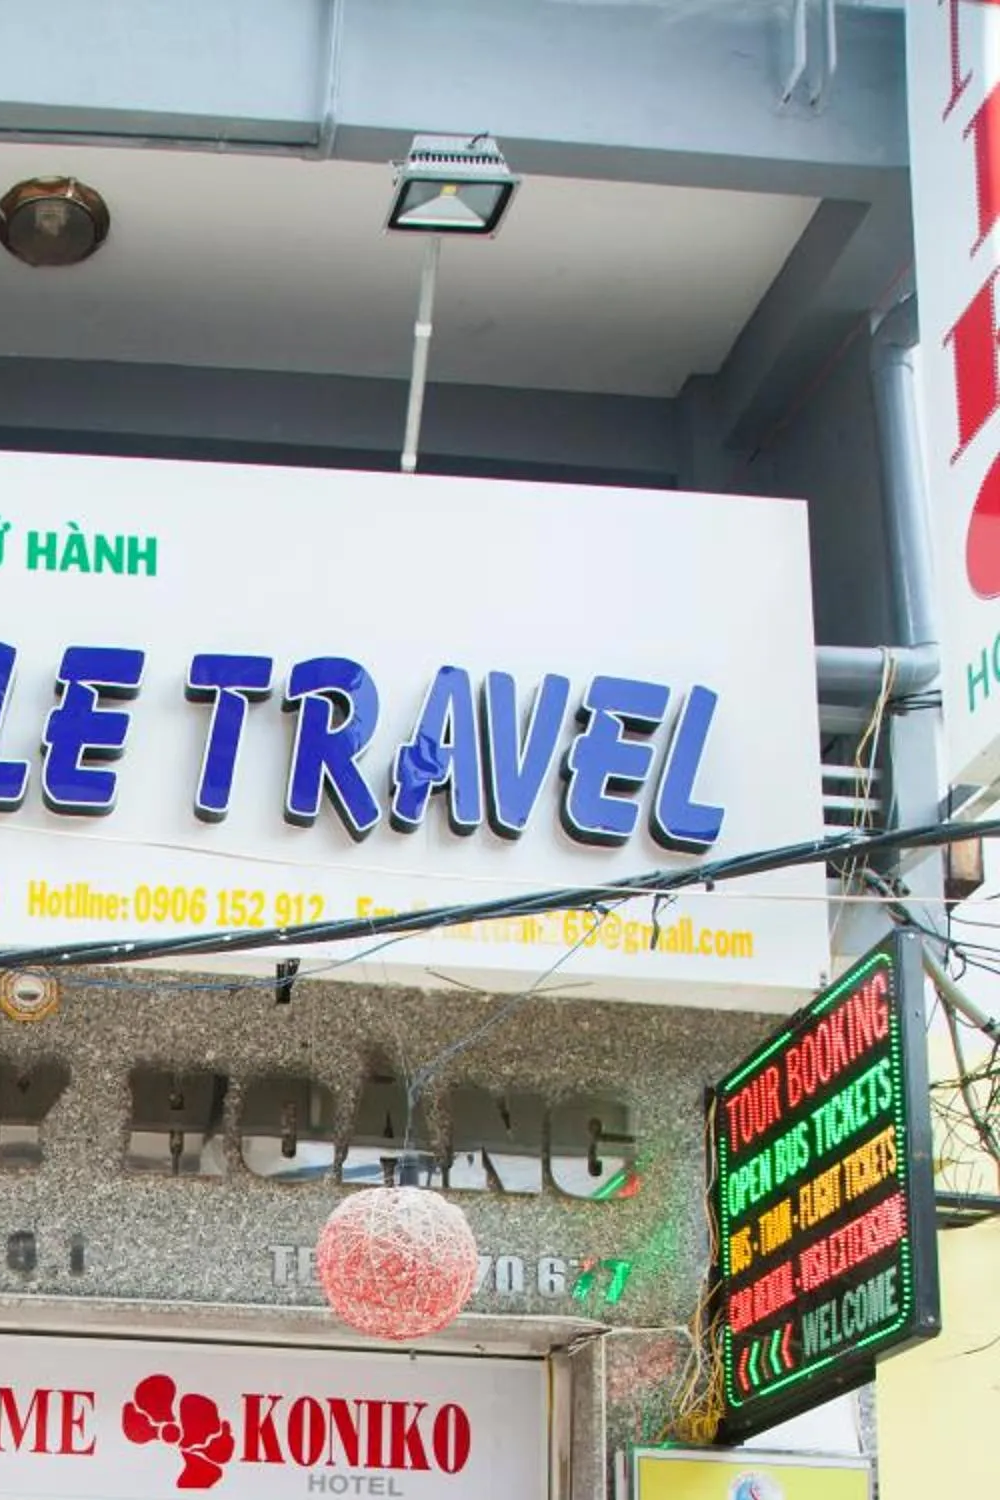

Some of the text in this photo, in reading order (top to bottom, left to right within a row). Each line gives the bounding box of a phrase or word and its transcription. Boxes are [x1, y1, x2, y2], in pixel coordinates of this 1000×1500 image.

[25, 520, 159, 577] HÀNH
[185, 653, 728, 852] TRAVEL
[27, 879, 130, 922] Hotline:
[134, 884, 207, 925] 0906
[215, 888, 267, 929] 152
[726, 971, 890, 1153] TOUR BOOKING
[727, 1057, 893, 1218] OPEN BUS TICKETS
[842, 1125, 898, 1207] TICKETS
[801, 1265, 899, 1359] WELCOME
[239, 1392, 472, 1475] KONIKO
[307, 1472, 405, 1499] HOTEL
